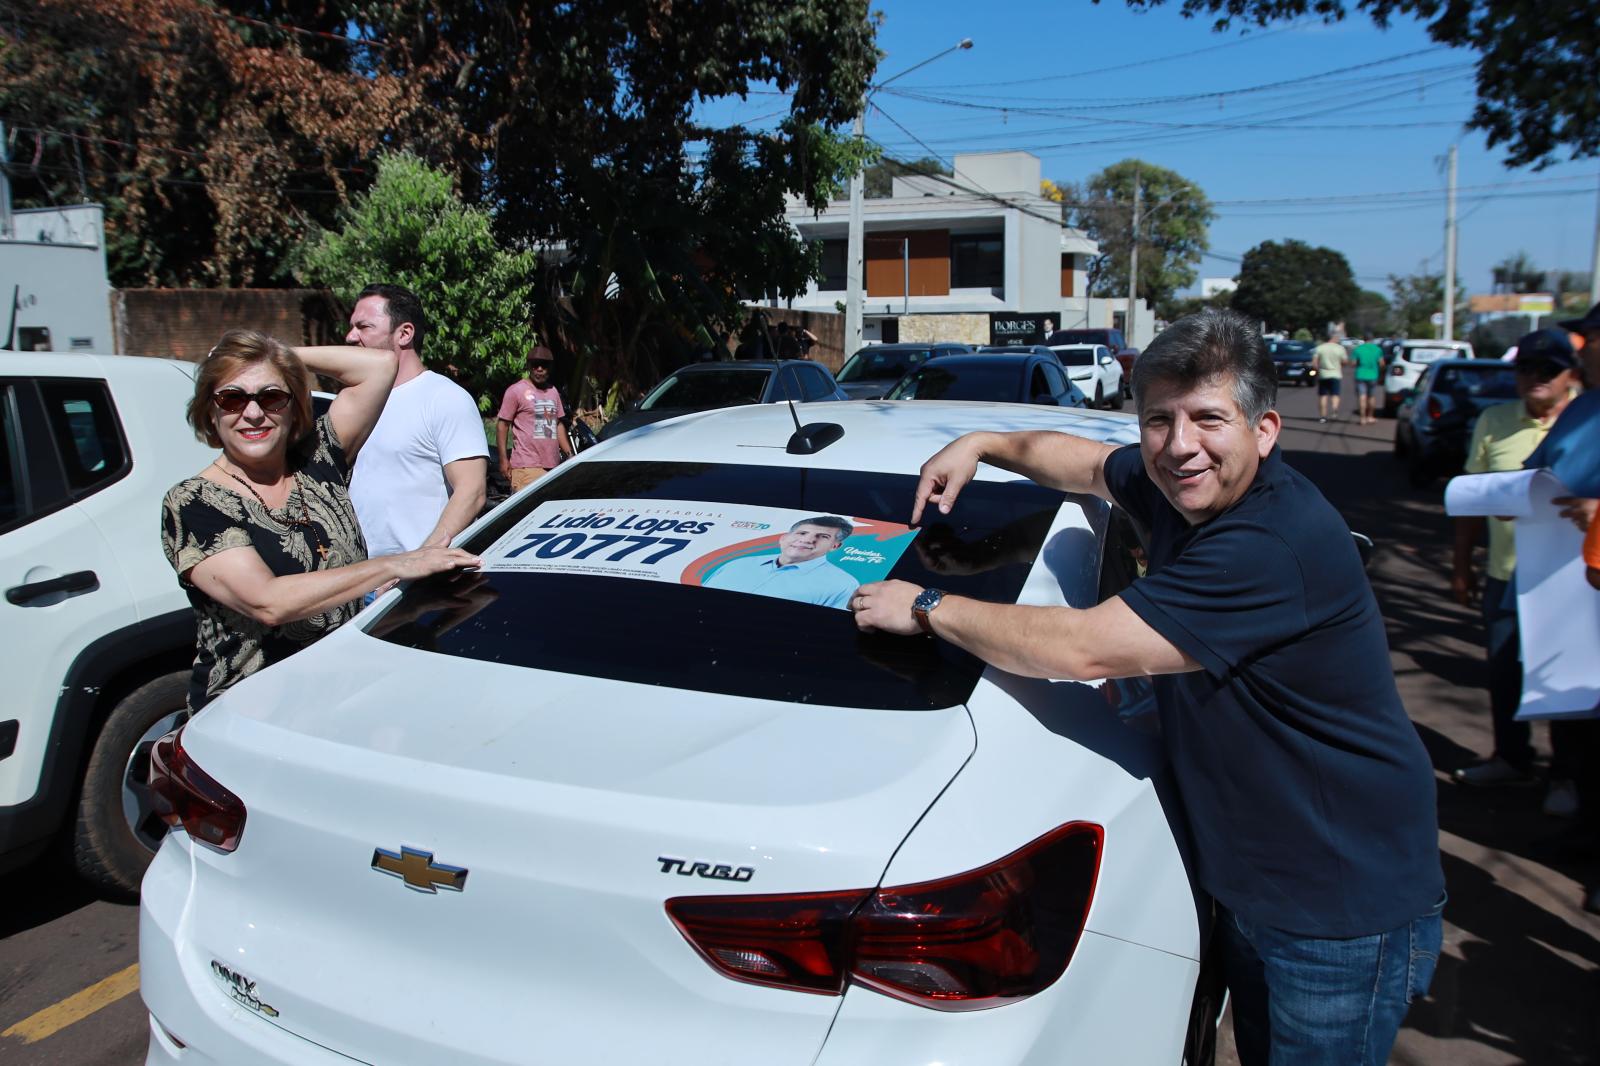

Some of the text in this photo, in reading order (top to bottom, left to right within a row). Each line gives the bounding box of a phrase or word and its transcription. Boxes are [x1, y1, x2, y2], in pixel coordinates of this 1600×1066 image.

[995, 321, 1036, 331] BORGES
[645, 509, 724, 518] ESTADUAL
[615, 514, 716, 536] Lopes
[503, 533, 691, 565] 70777
[657, 856, 755, 882] TURBO
